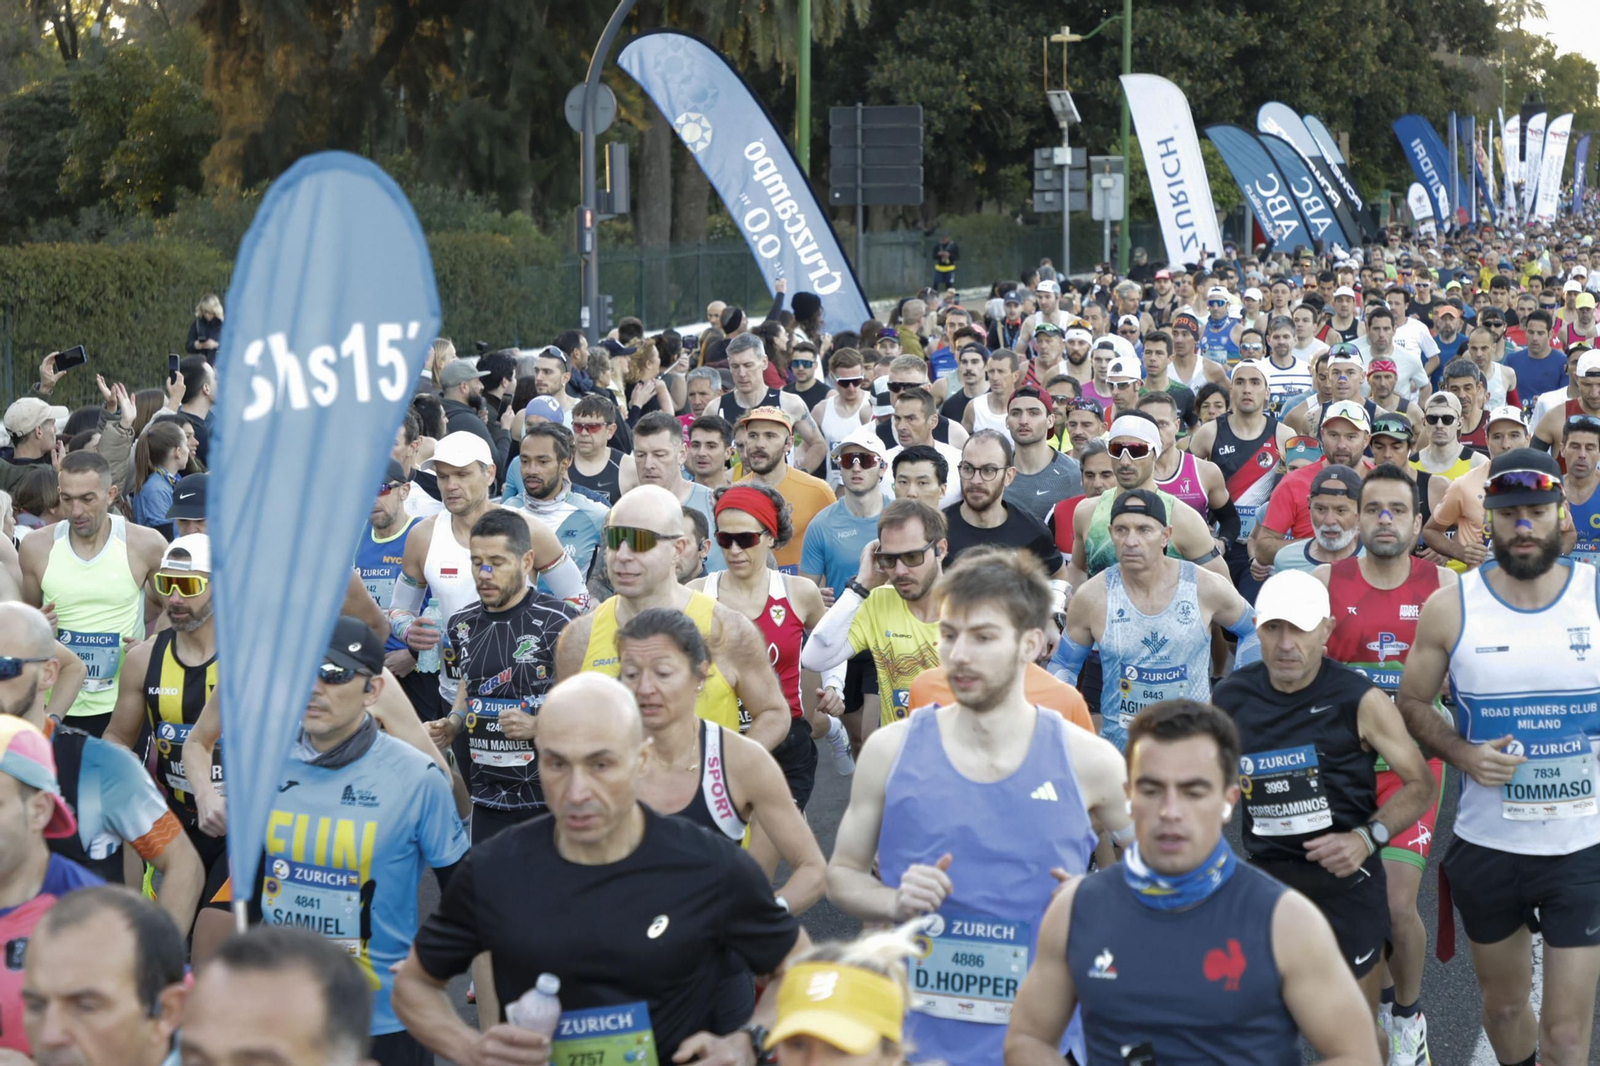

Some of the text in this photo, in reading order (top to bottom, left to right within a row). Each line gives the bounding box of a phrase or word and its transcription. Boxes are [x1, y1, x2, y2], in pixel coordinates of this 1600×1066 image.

[837, 529, 857, 539] HOKA
[378, 557, 401, 567] NYC
[362, 568, 390, 578] ZURICH
[75, 635, 114, 645] ZURICH
[479, 667, 512, 695] MRW
[1142, 667, 1180, 681] ZURICH
[148, 686, 179, 696] KAIXO
[1143, 690, 1163, 700] 6443
[1481, 702, 1598, 718] ROAD RUNNERS CLUB
[1517, 718, 1561, 730] MILANO
[490, 740, 533, 751] MANUEL
[1530, 740, 1581, 756] ZURICH
[1258, 752, 1306, 770] ZURICH
[1533, 767, 1561, 779] 7834
[707, 756, 734, 821] SPORT
[1264, 780, 1290, 794] 3993
[1504, 779, 1592, 801] TOMMASO
[1247, 796, 1329, 818] CORRECAMINOS
[294, 868, 347, 886] ZURICH
[294, 895, 321, 910] 4841
[272, 908, 346, 936] SAMUEL
[951, 920, 1016, 940] ZURICH
[951, 953, 985, 968] 4886
[915, 968, 1019, 999] D.HOPPER
[559, 1011, 635, 1036] ZURICH
